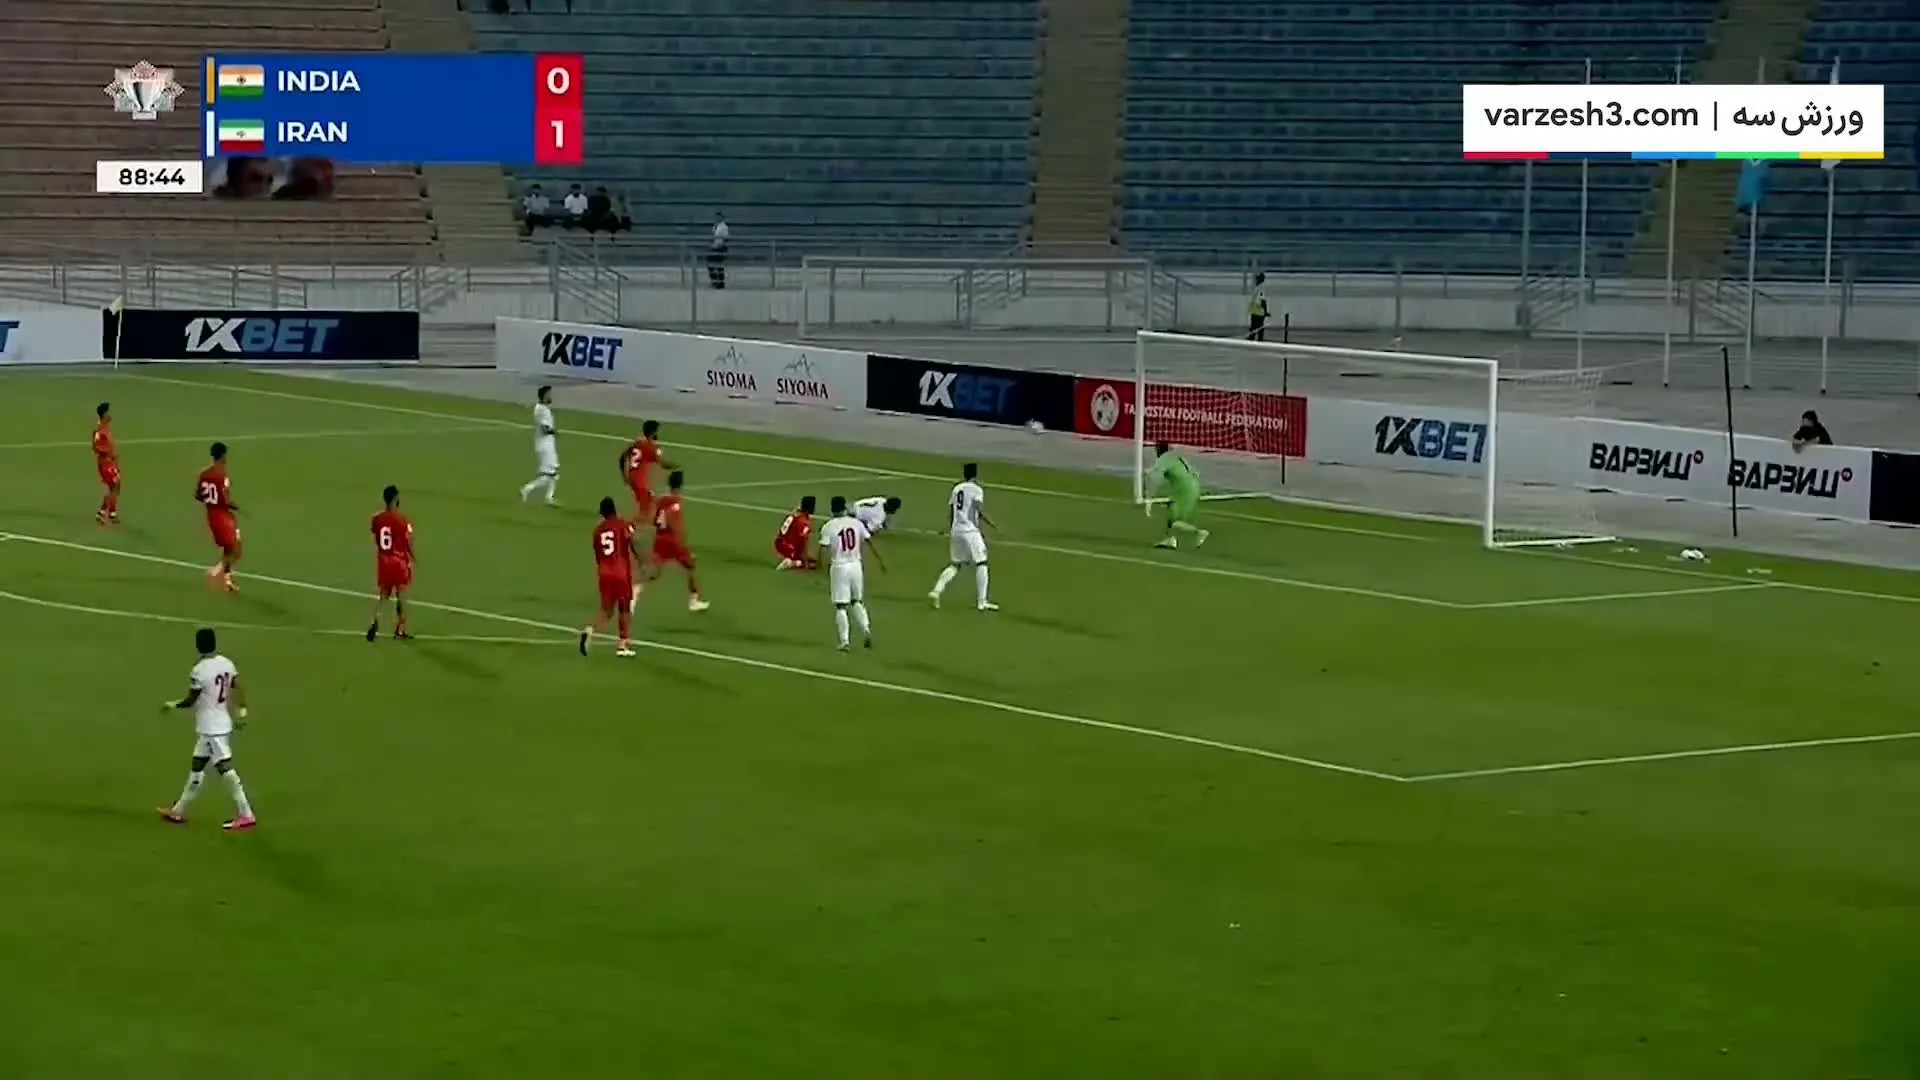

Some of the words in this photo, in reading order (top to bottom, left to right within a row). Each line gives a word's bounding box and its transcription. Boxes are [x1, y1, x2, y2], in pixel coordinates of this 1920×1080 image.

[184, 317, 340, 353] 1XBET
[541, 332, 623, 371] 1XBET
[706, 370, 758, 392] SIYOMA
[776, 377, 829, 400] SIYOMA
[919, 370, 1017, 415] 1XBET
[1375, 415, 1488, 464] 1XBET
[1589, 442, 1693, 481] ВАРЗИШ
[201, 481, 218, 505] 20
[956, 490, 965, 511] 9
[380, 526, 393, 551] 6
[600, 530, 615, 556] 5
[837, 527, 857, 552] 10
